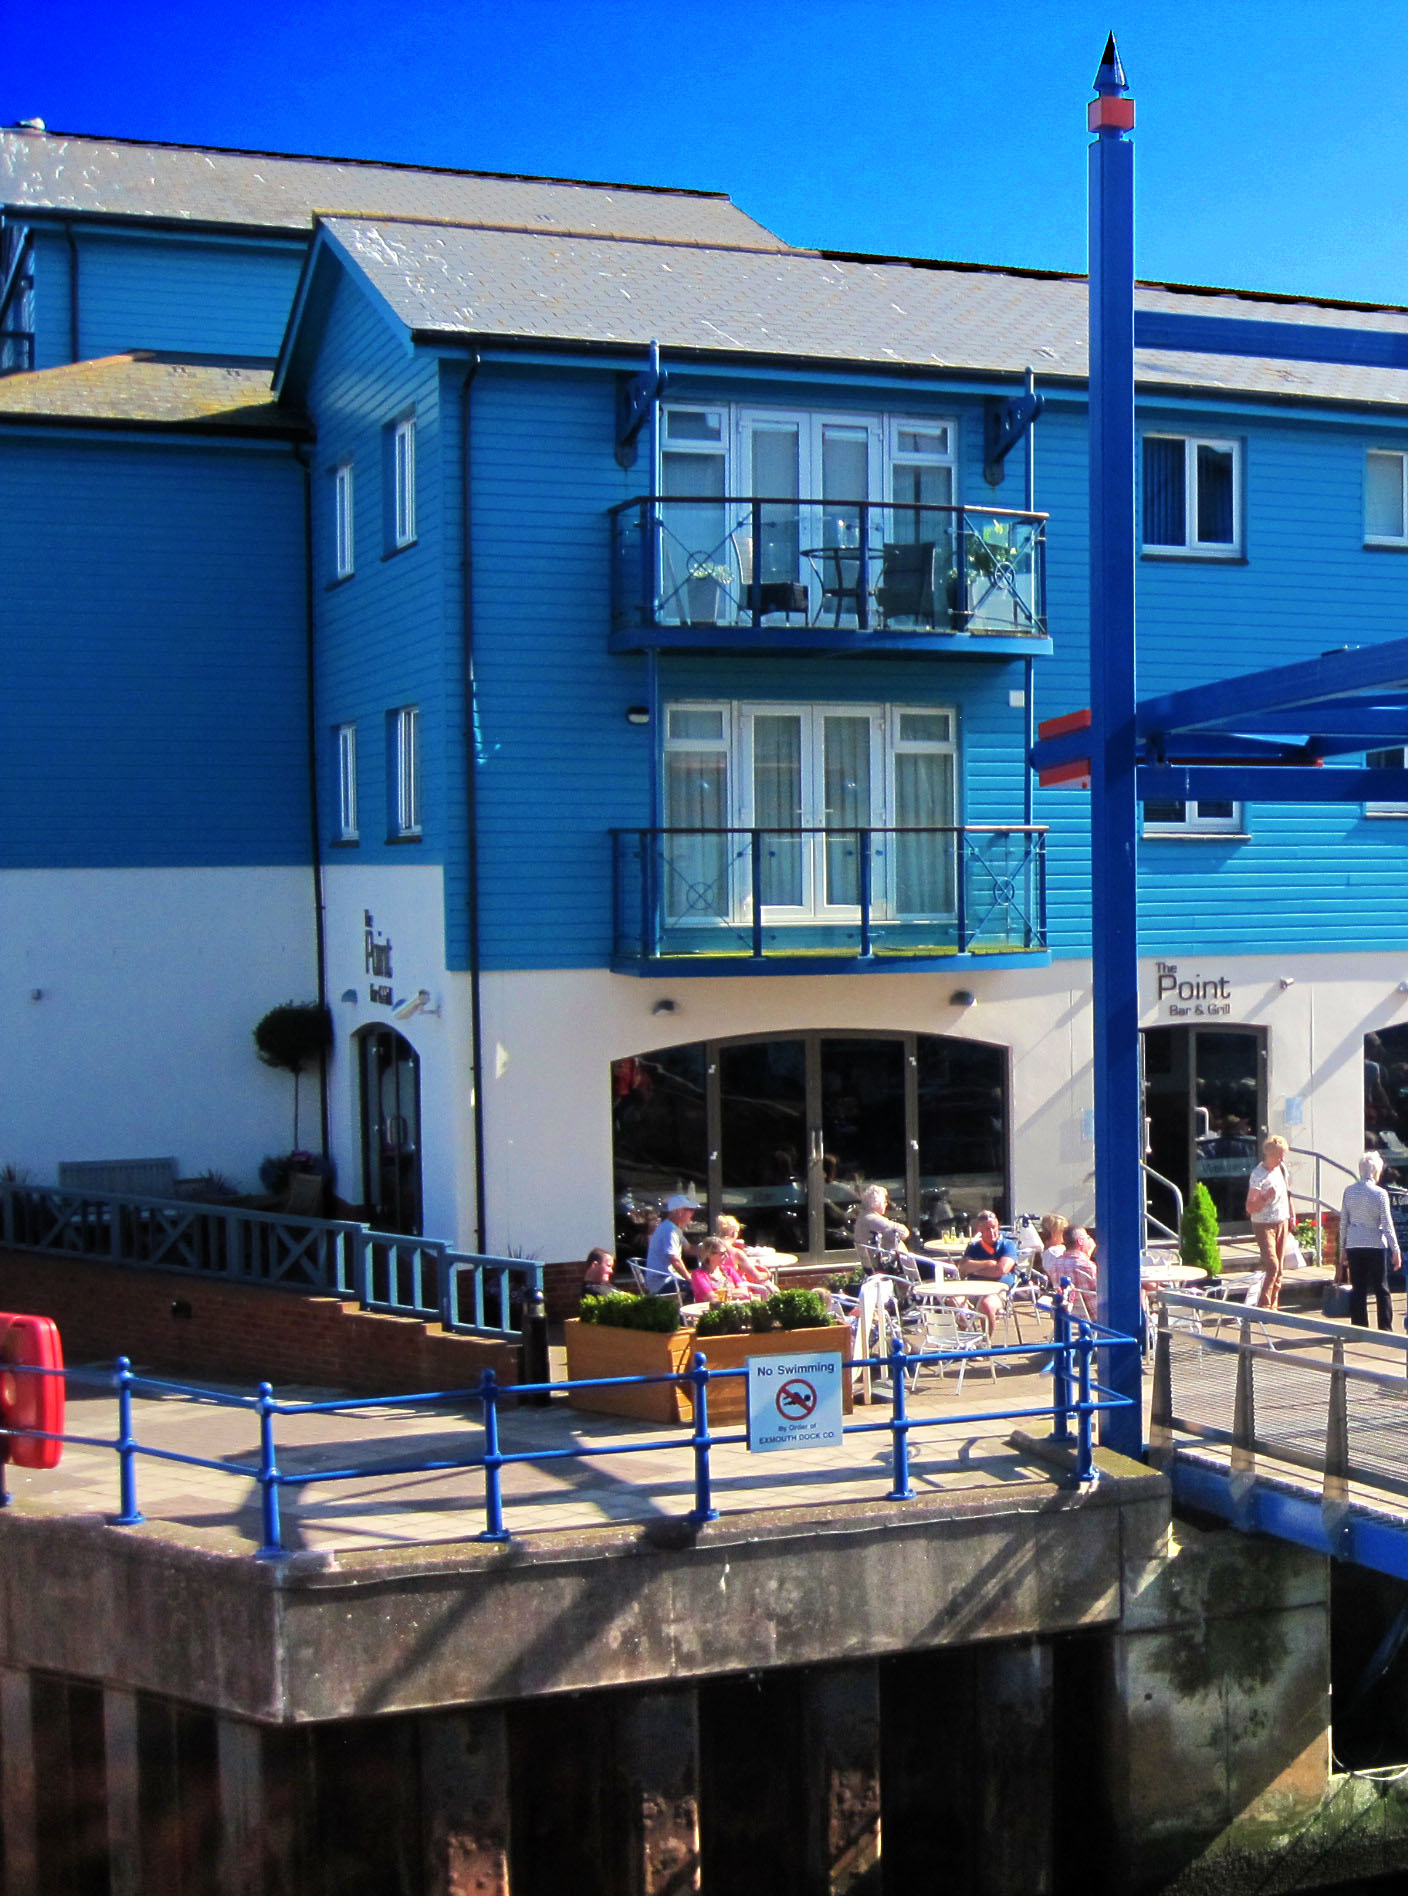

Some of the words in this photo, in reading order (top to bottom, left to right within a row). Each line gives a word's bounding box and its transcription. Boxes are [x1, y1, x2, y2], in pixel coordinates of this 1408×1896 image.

[1155, 962, 1177, 974] The
[1158, 973, 1231, 1001] Point
[1169, 1004, 1191, 1016] Bar
[1194, 1004, 1204, 1016] &
[1207, 1003, 1231, 1015] Grill
[757, 1366, 773, 1377] No
[777, 1362, 835, 1375] Swimming
[778, 1425, 787, 1433] By
[788, 1423, 808, 1431] Order
[759, 1434, 797, 1444] EXMOUTH
[799, 1432, 820, 1441] DOCK
